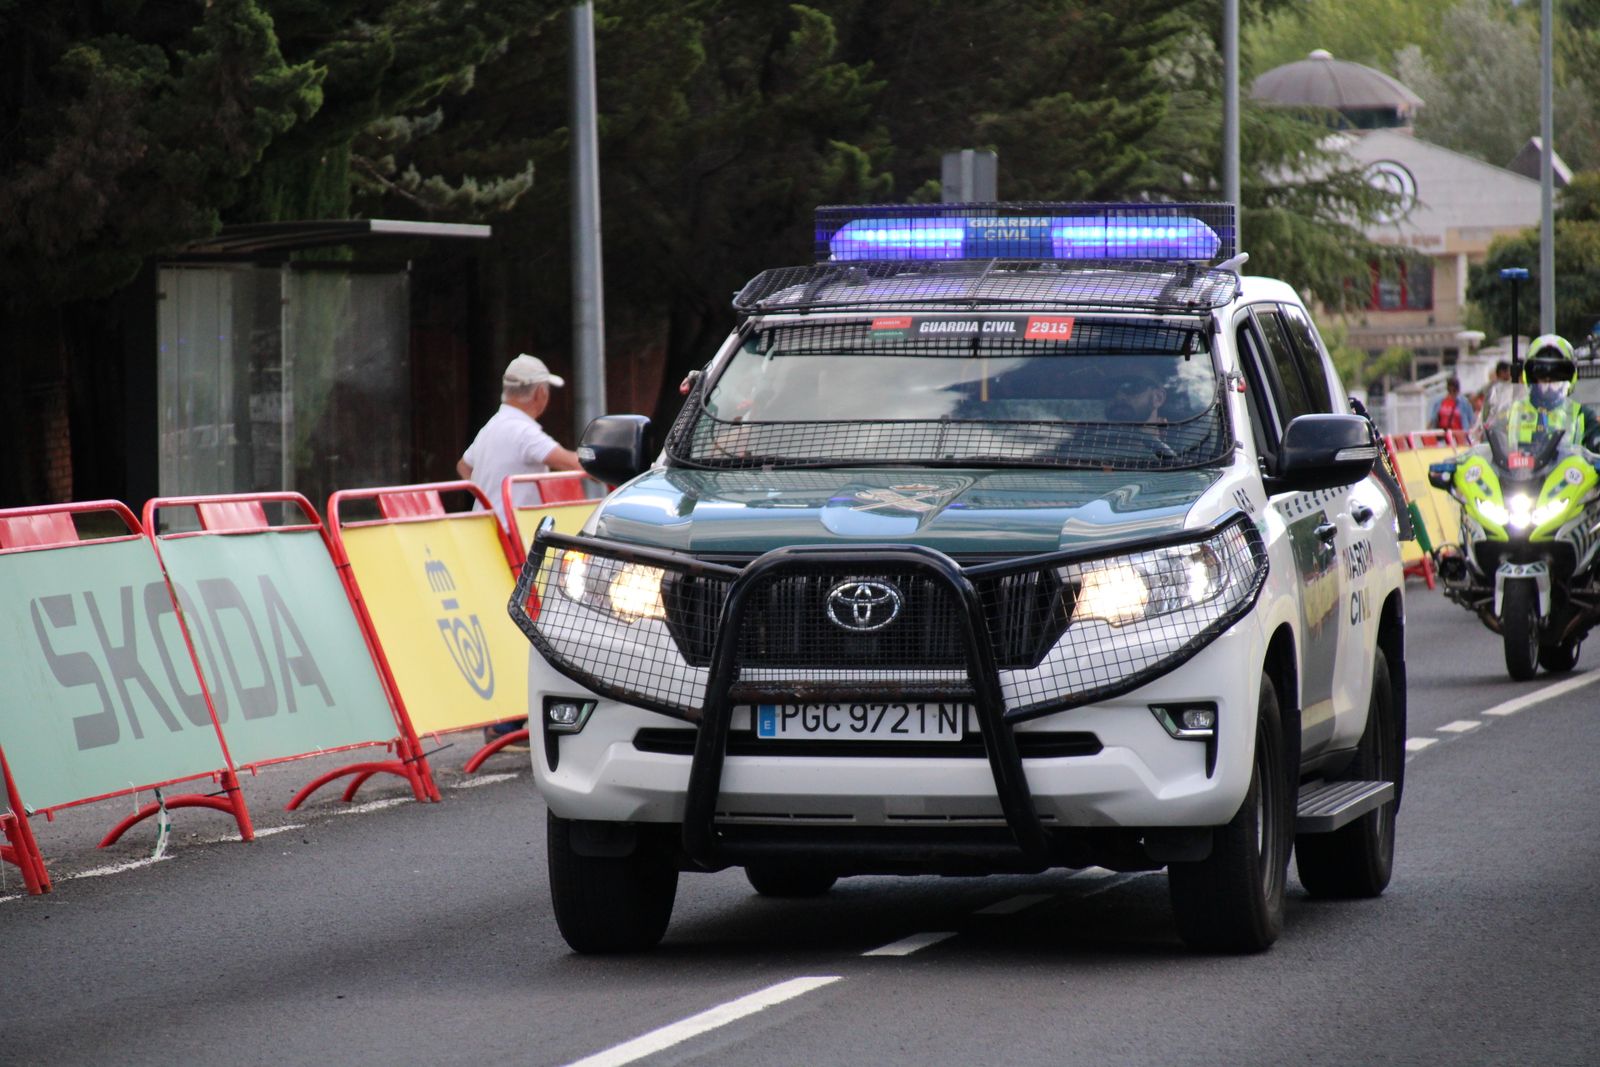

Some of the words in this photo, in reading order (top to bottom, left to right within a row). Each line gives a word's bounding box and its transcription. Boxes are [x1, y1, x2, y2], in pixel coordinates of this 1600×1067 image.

[969, 218, 1048, 228] GUARDIA
[984, 229, 1030, 241] CIVIL
[919, 321, 979, 333] GUARDIA
[982, 321, 1017, 333] CIVIL
[1030, 321, 1069, 335] 2915
[781, 703, 841, 733] PGC
[849, 703, 926, 734] 9721
[764, 720, 771, 730] E
